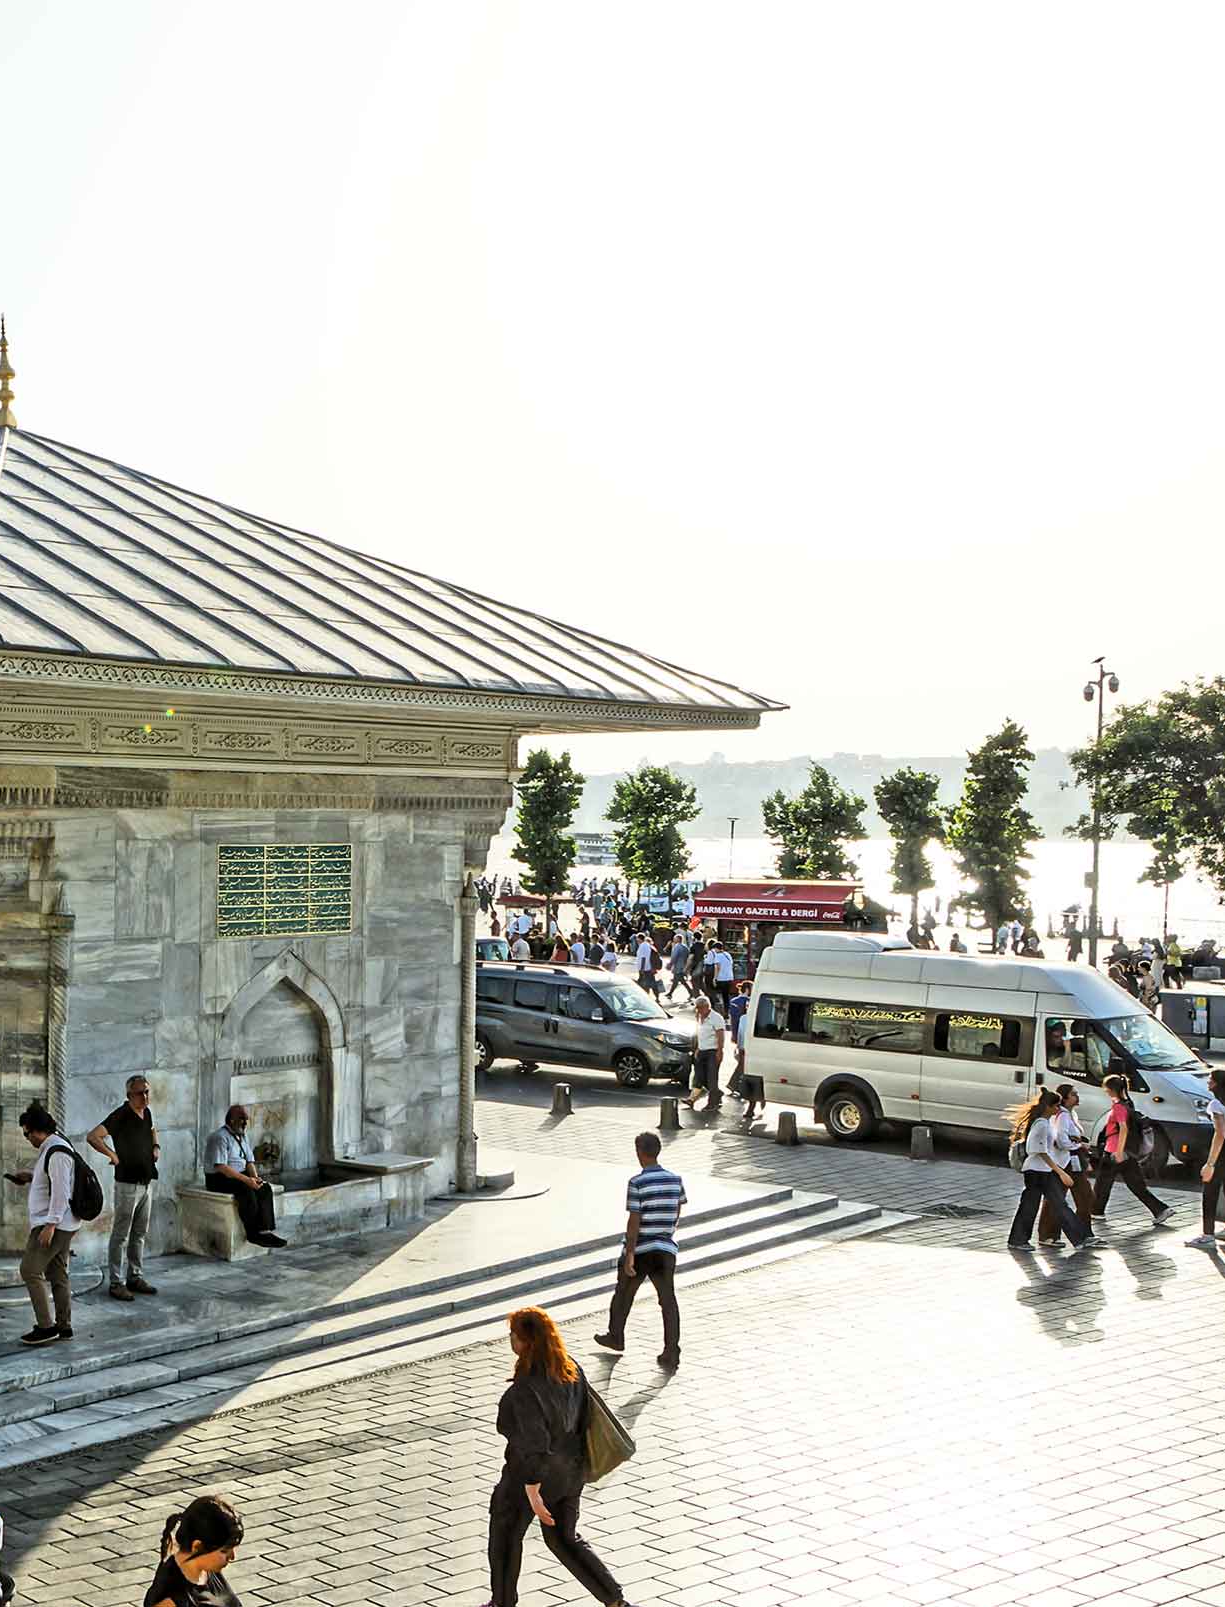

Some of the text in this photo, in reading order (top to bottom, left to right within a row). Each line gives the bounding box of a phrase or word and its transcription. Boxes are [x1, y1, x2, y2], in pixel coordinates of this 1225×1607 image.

[696, 906, 818, 918] MARMARAY GAZETE & DERGİ
